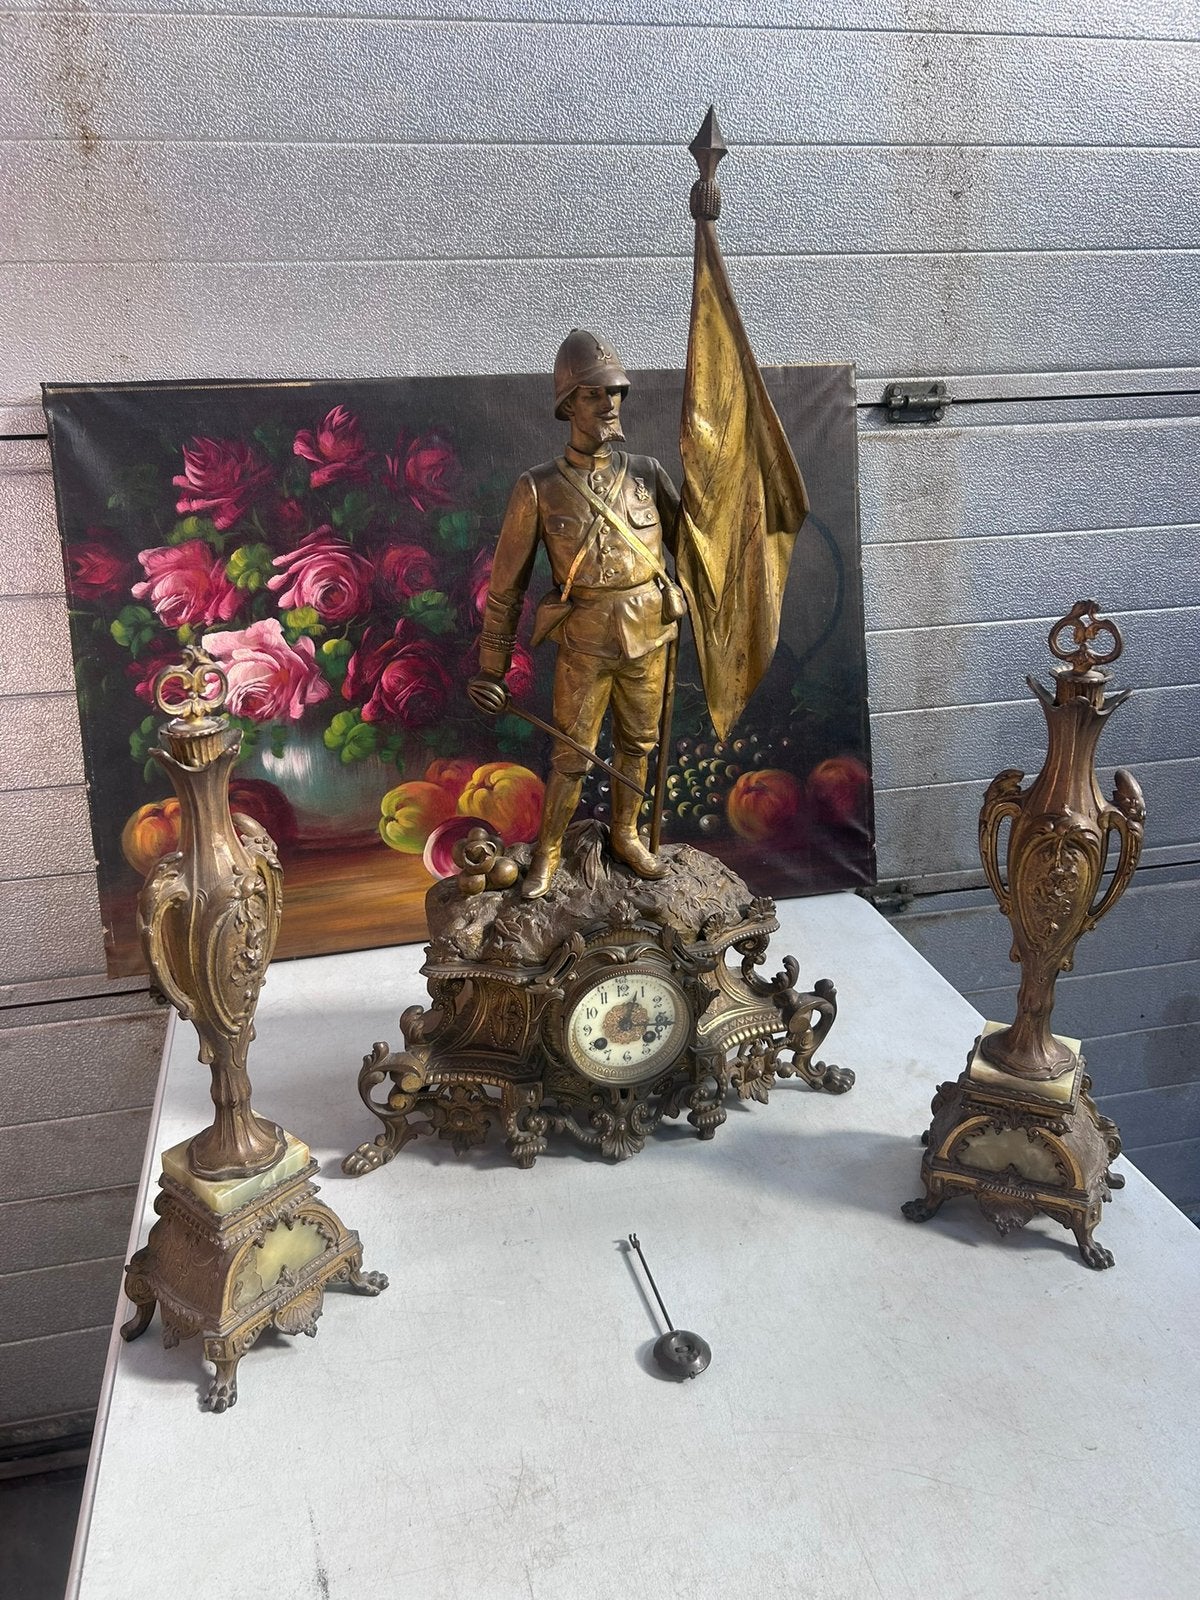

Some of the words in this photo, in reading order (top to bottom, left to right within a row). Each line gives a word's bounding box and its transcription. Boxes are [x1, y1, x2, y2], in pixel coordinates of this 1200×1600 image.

[617, 984, 630, 998] 12
[641, 986, 645, 998] 1
[652, 995, 663, 1009] 2
[586, 1007, 599, 1019] 10
[583, 1024, 592, 1036] 9
[604, 1049, 612, 1061] 7
[641, 1044, 651, 1056] 5
[623, 1051, 632, 1063] 6
